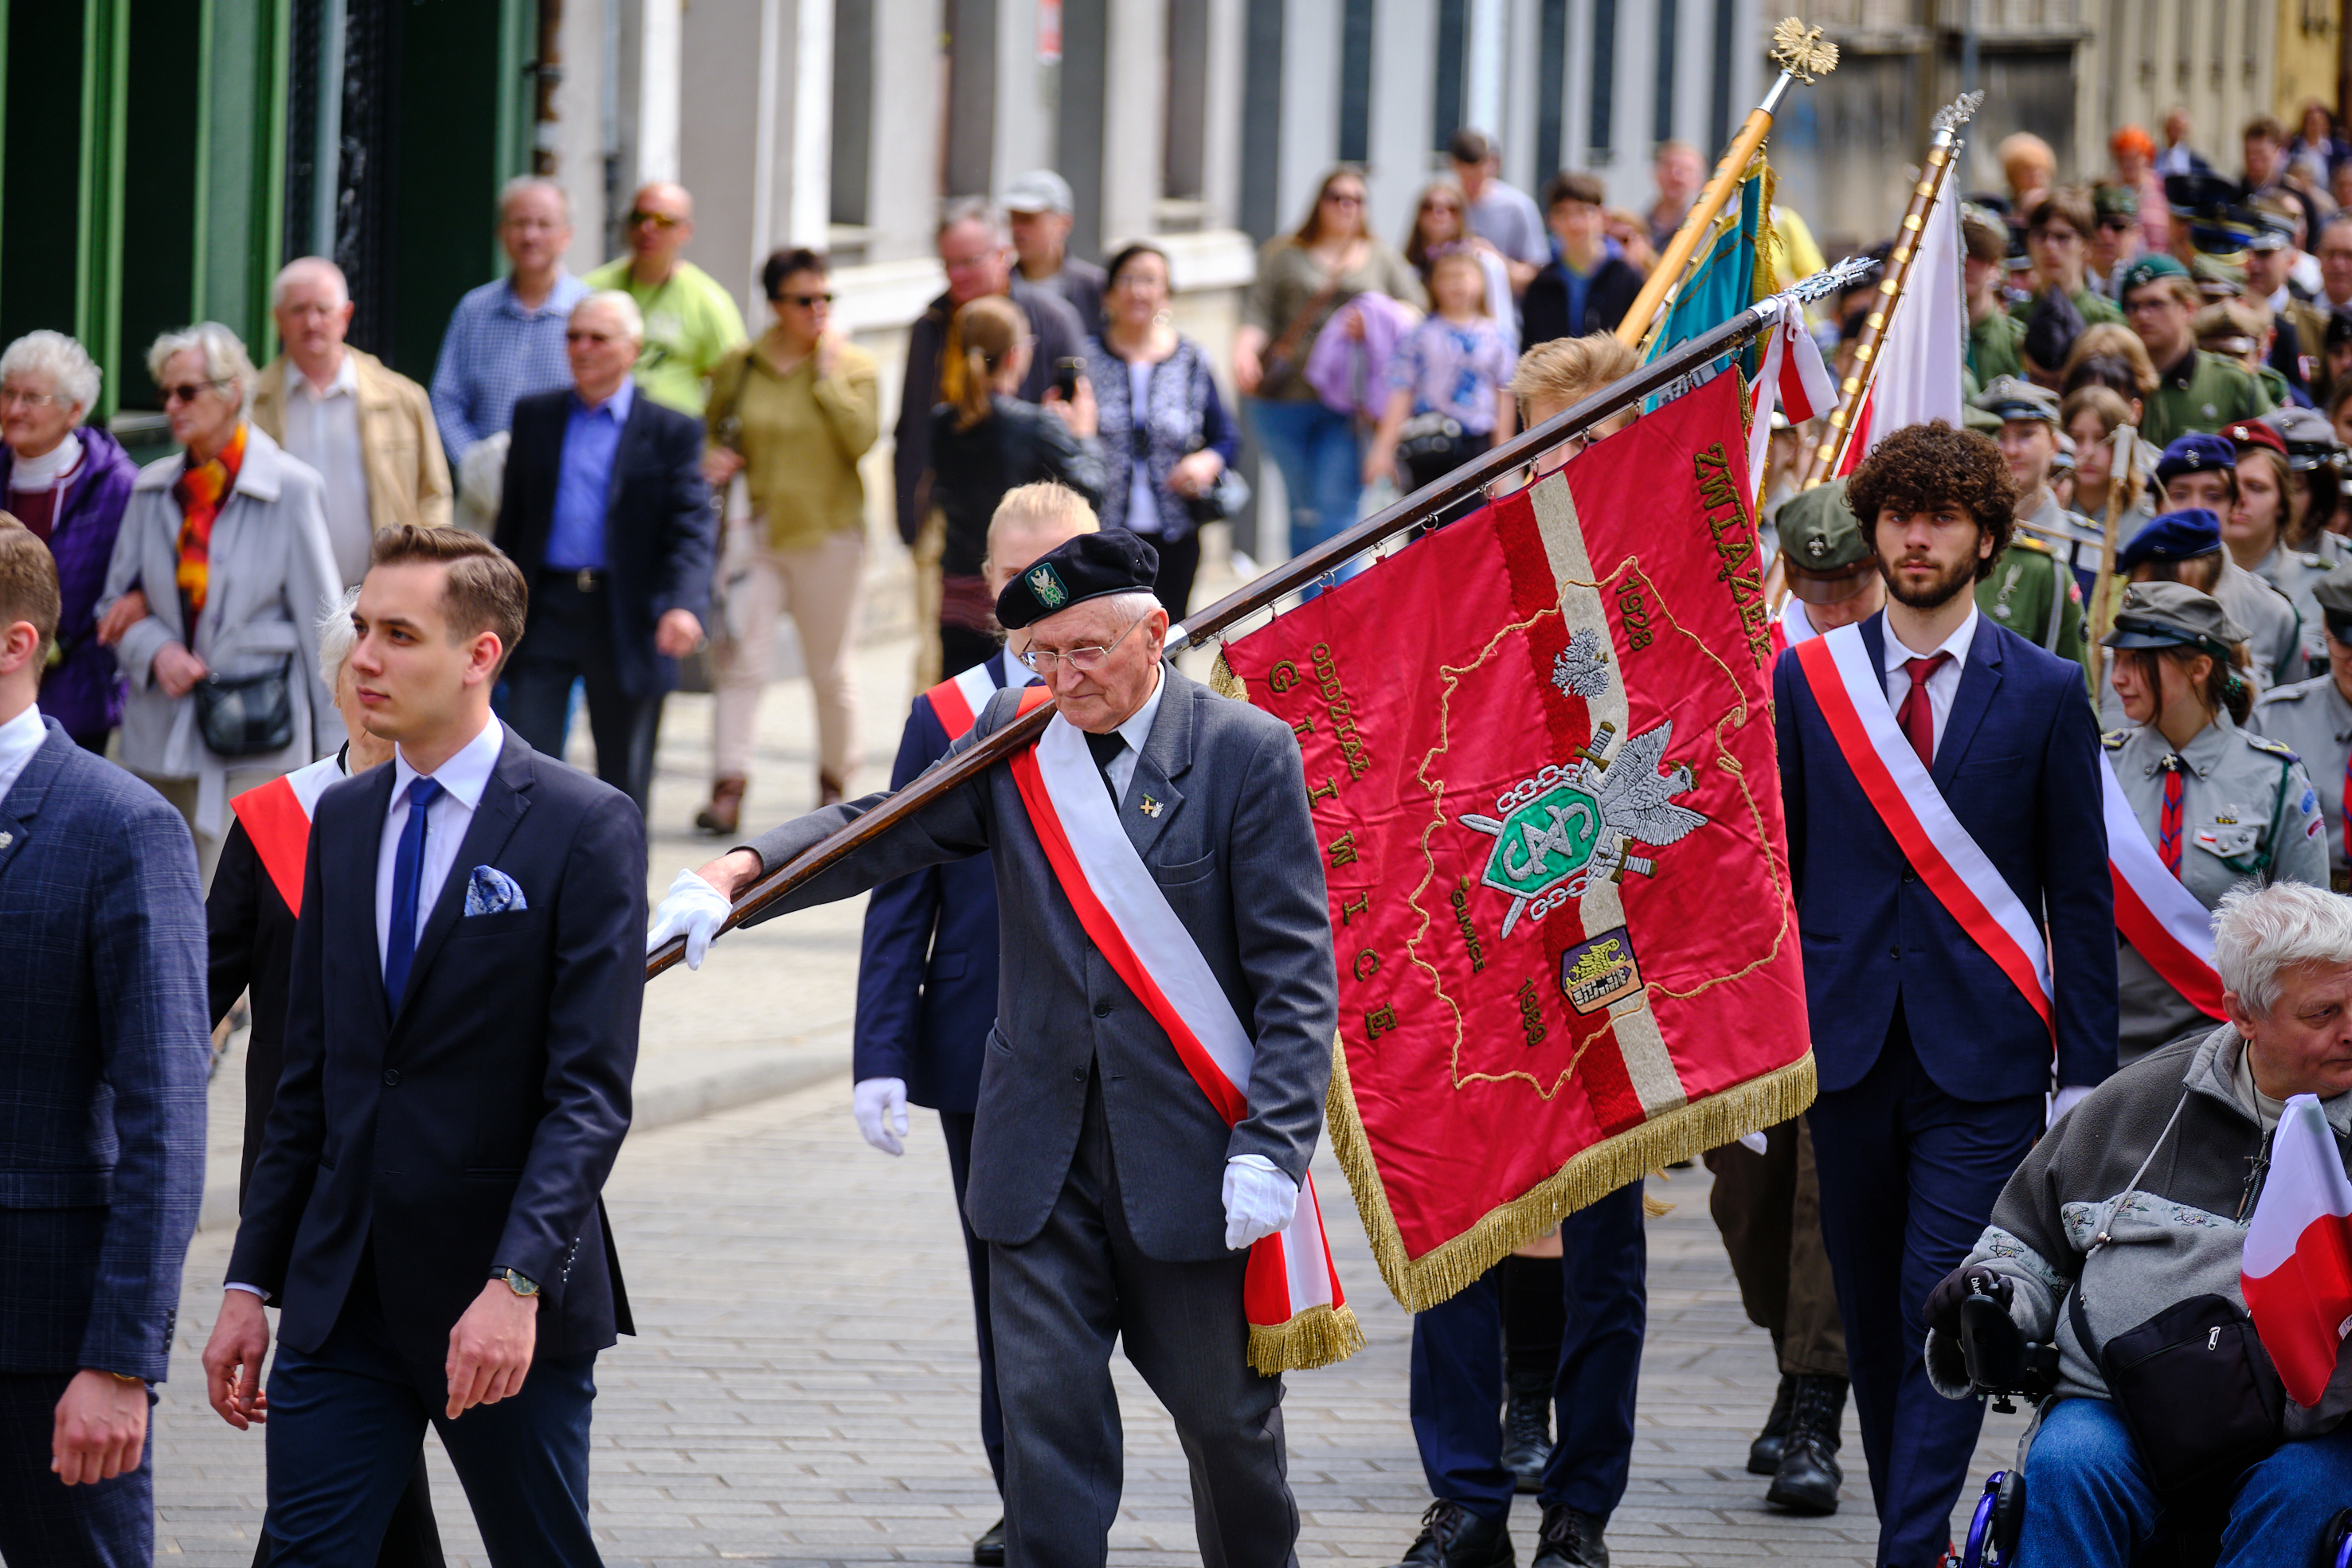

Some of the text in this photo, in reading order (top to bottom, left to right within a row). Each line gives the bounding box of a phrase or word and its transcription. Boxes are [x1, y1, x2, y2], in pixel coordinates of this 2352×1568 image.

[1693, 442, 1772, 670] ZWIĄZEK
[1615, 575, 1654, 651] 1928
[1310, 643, 1372, 781] ODDZIAŁ
[1269, 660, 1399, 1040] GLIWICE
[1451, 889, 1485, 973] GLIWICE
[1518, 976, 1548, 1046] 1989
